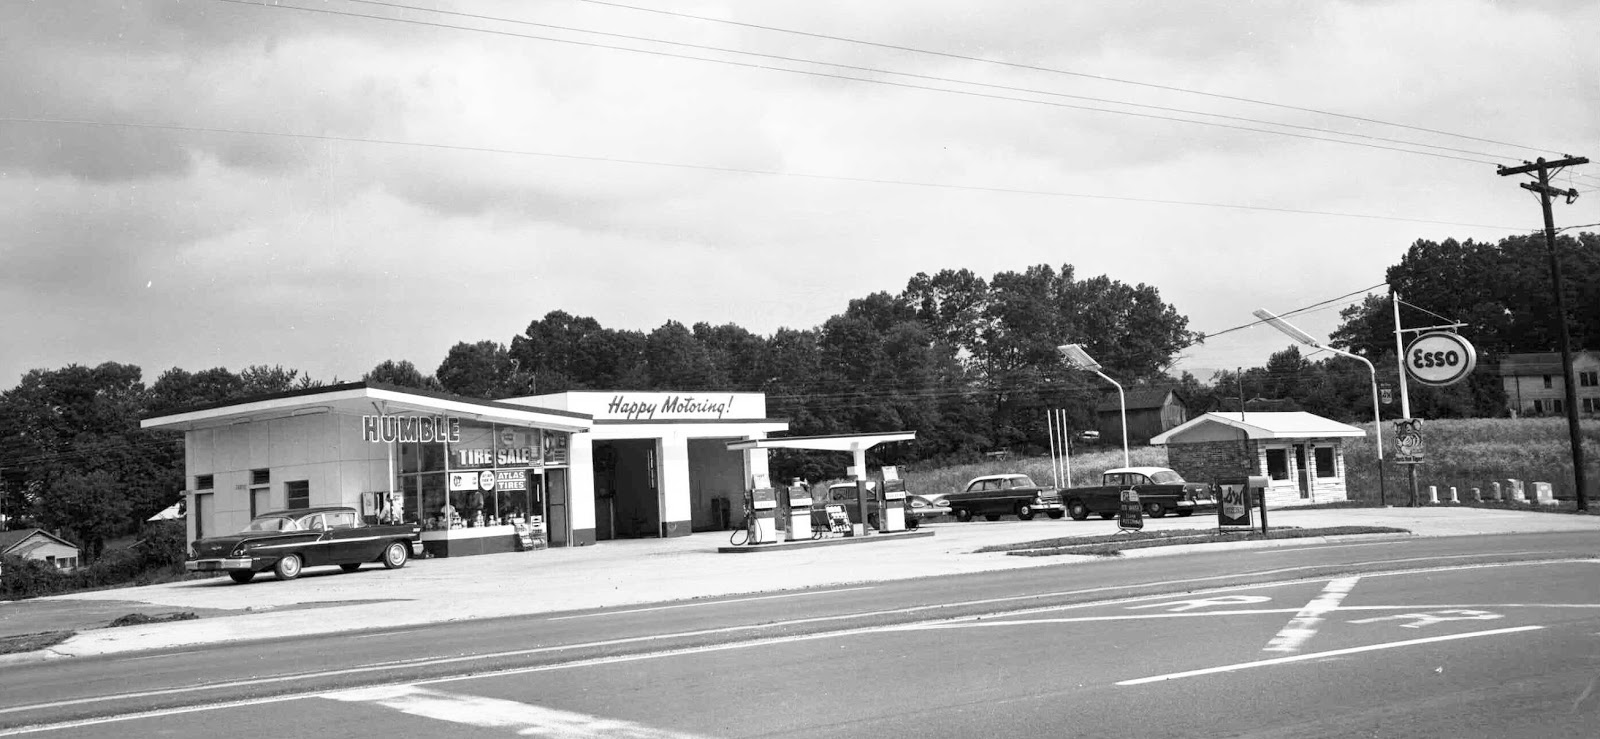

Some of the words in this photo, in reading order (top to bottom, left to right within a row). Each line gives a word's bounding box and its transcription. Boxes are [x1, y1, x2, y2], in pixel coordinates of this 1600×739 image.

[1413, 348, 1459, 369] Esso
[608, 395, 657, 420] Happy
[661, 395, 734, 420] Motoring!
[362, 415, 460, 443] HUMBLE
[458, 449, 493, 466] TIRE
[497, 448, 530, 466] SALE
[498, 471, 525, 480] ATLAS
[498, 481, 525, 490] TIRES
